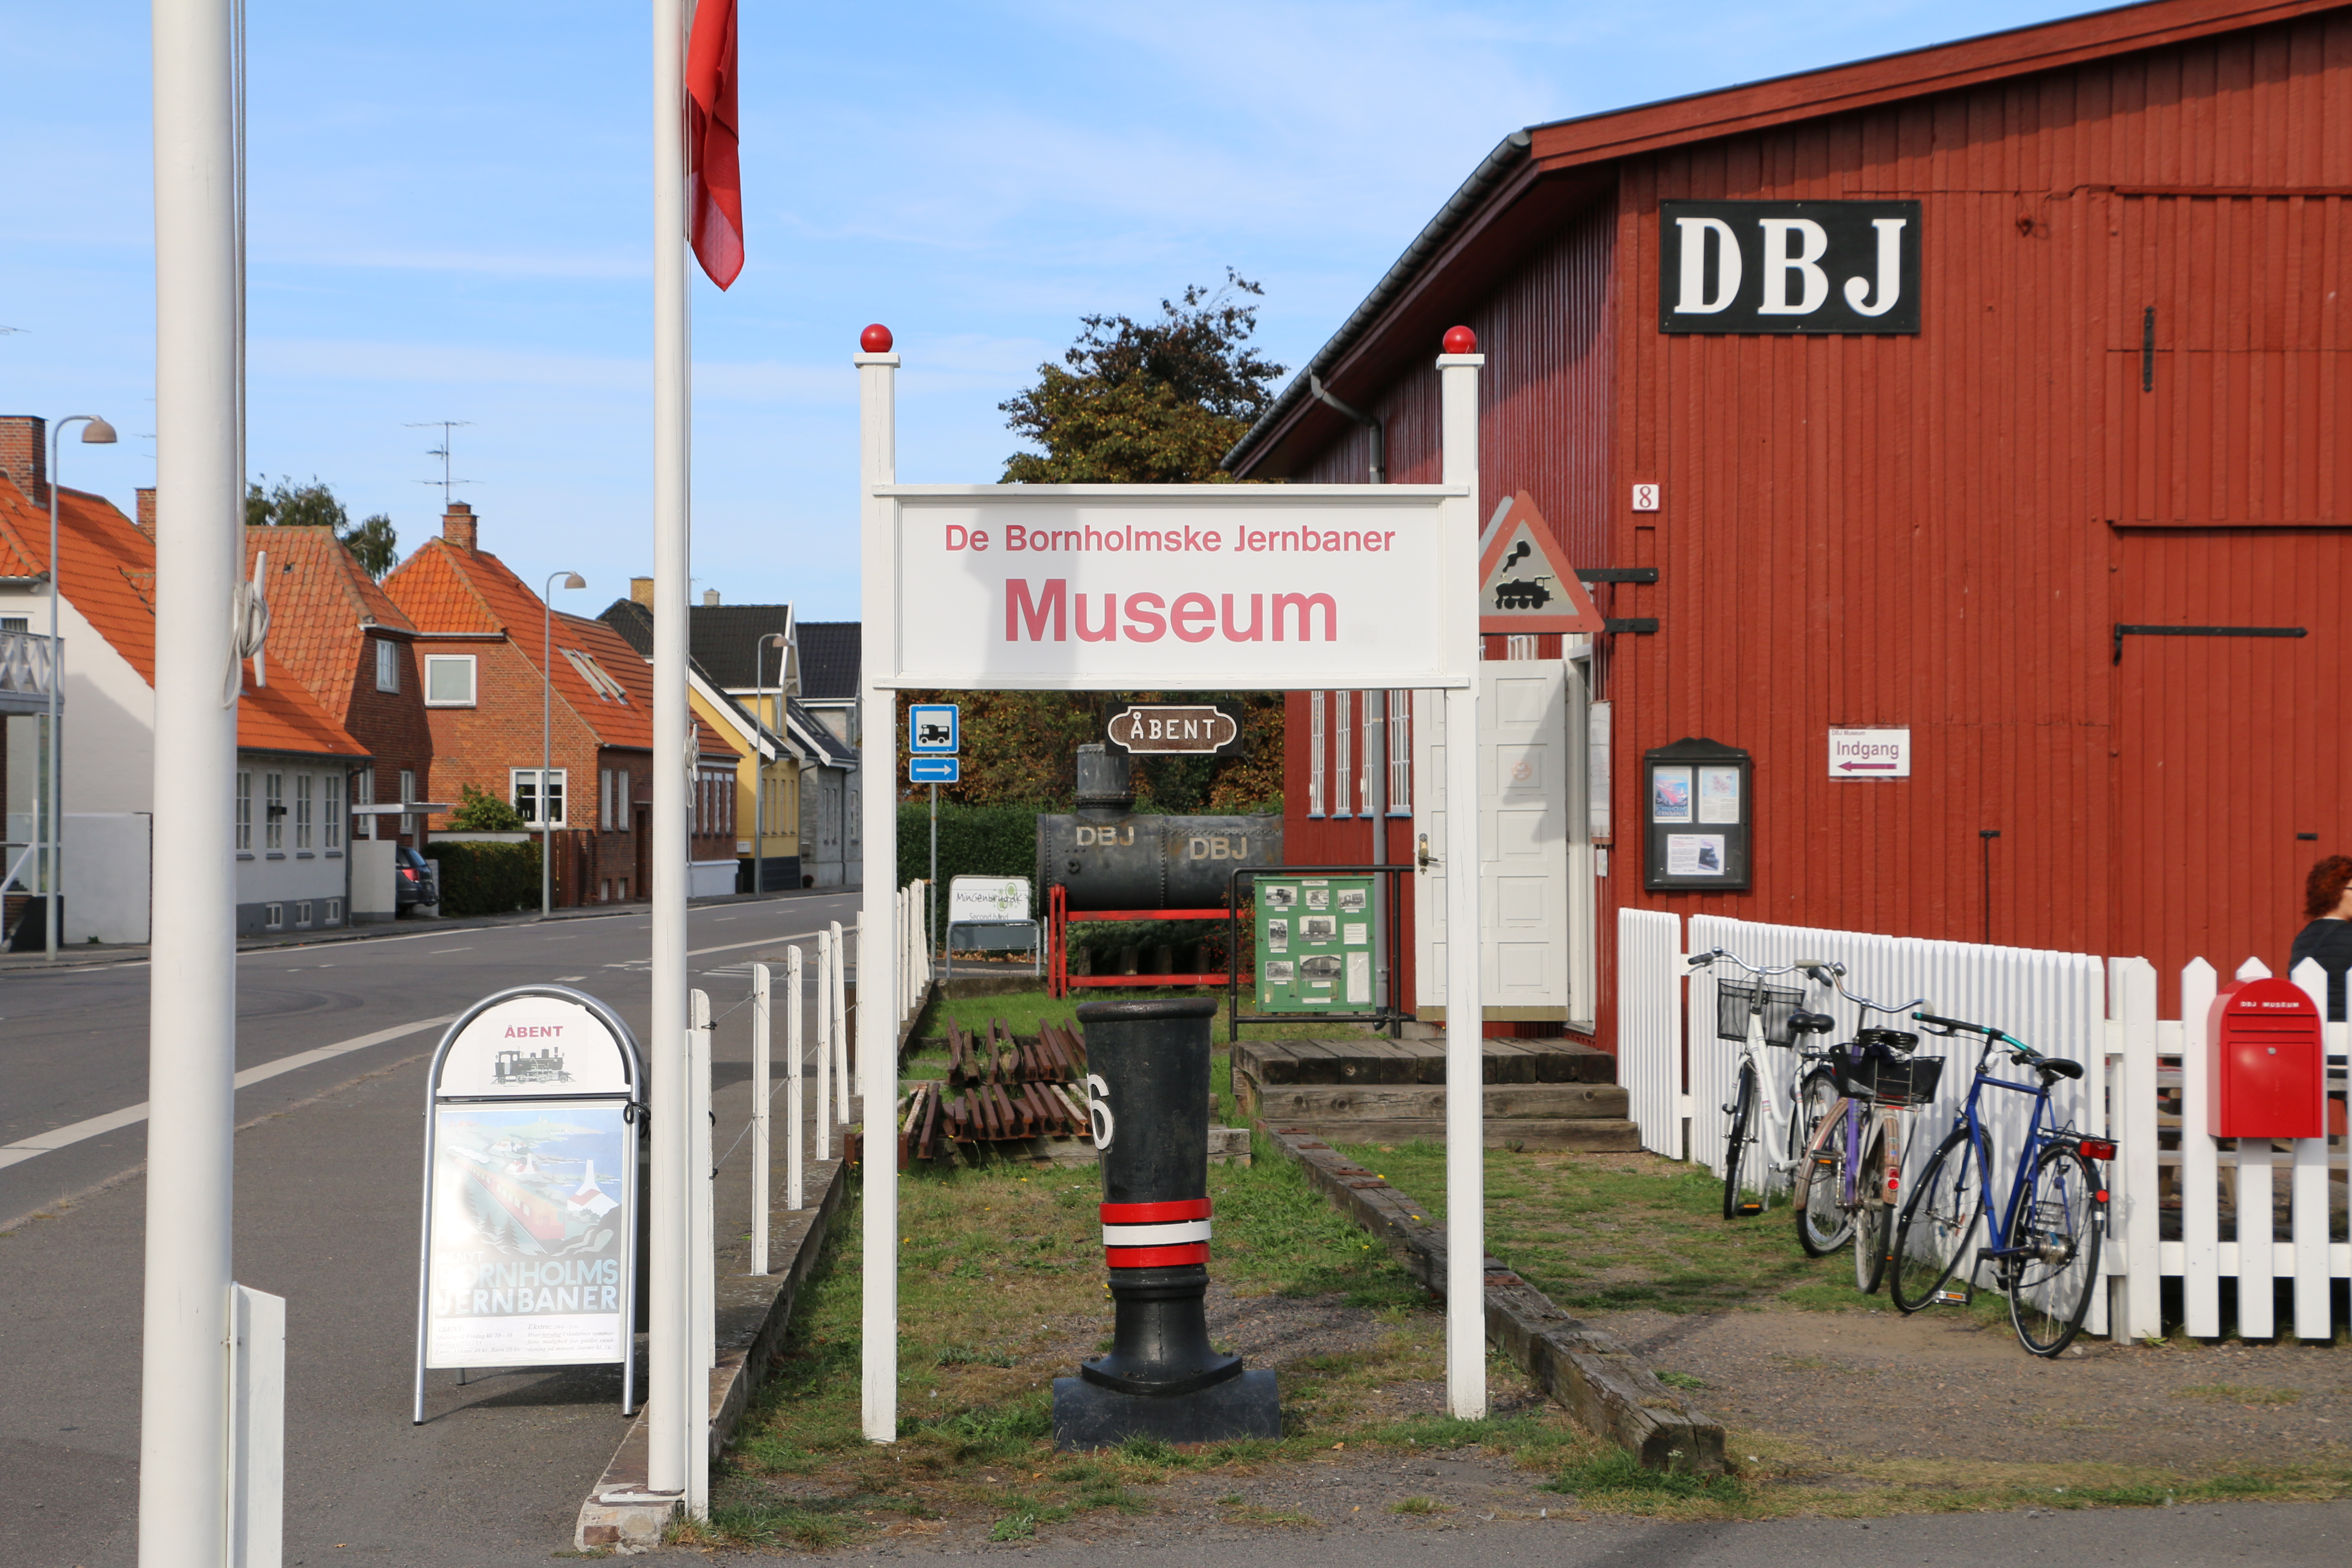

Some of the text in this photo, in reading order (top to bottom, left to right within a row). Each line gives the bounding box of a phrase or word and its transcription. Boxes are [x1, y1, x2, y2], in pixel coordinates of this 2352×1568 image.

[1674, 217, 1907, 317] DBJ
[1639, 486, 1652, 508] 8
[946, 525, 1395, 551] De Bornholmske Jernbaner
[1007, 579, 1336, 642] Museum
[1130, 711, 1215, 739] ÅBENT
[1837, 741, 1899, 759] Indgang
[1077, 827, 1134, 846] DBJ
[1189, 837, 1247, 860] DBJ
[970, 913, 991, 921] Second
[504, 1025, 563, 1038] ÅBENT
[1087, 1073, 1114, 1150] 6
[438, 1259, 618, 1289] BORNHOLMS
[436, 1286, 617, 1315] JERNBANER
